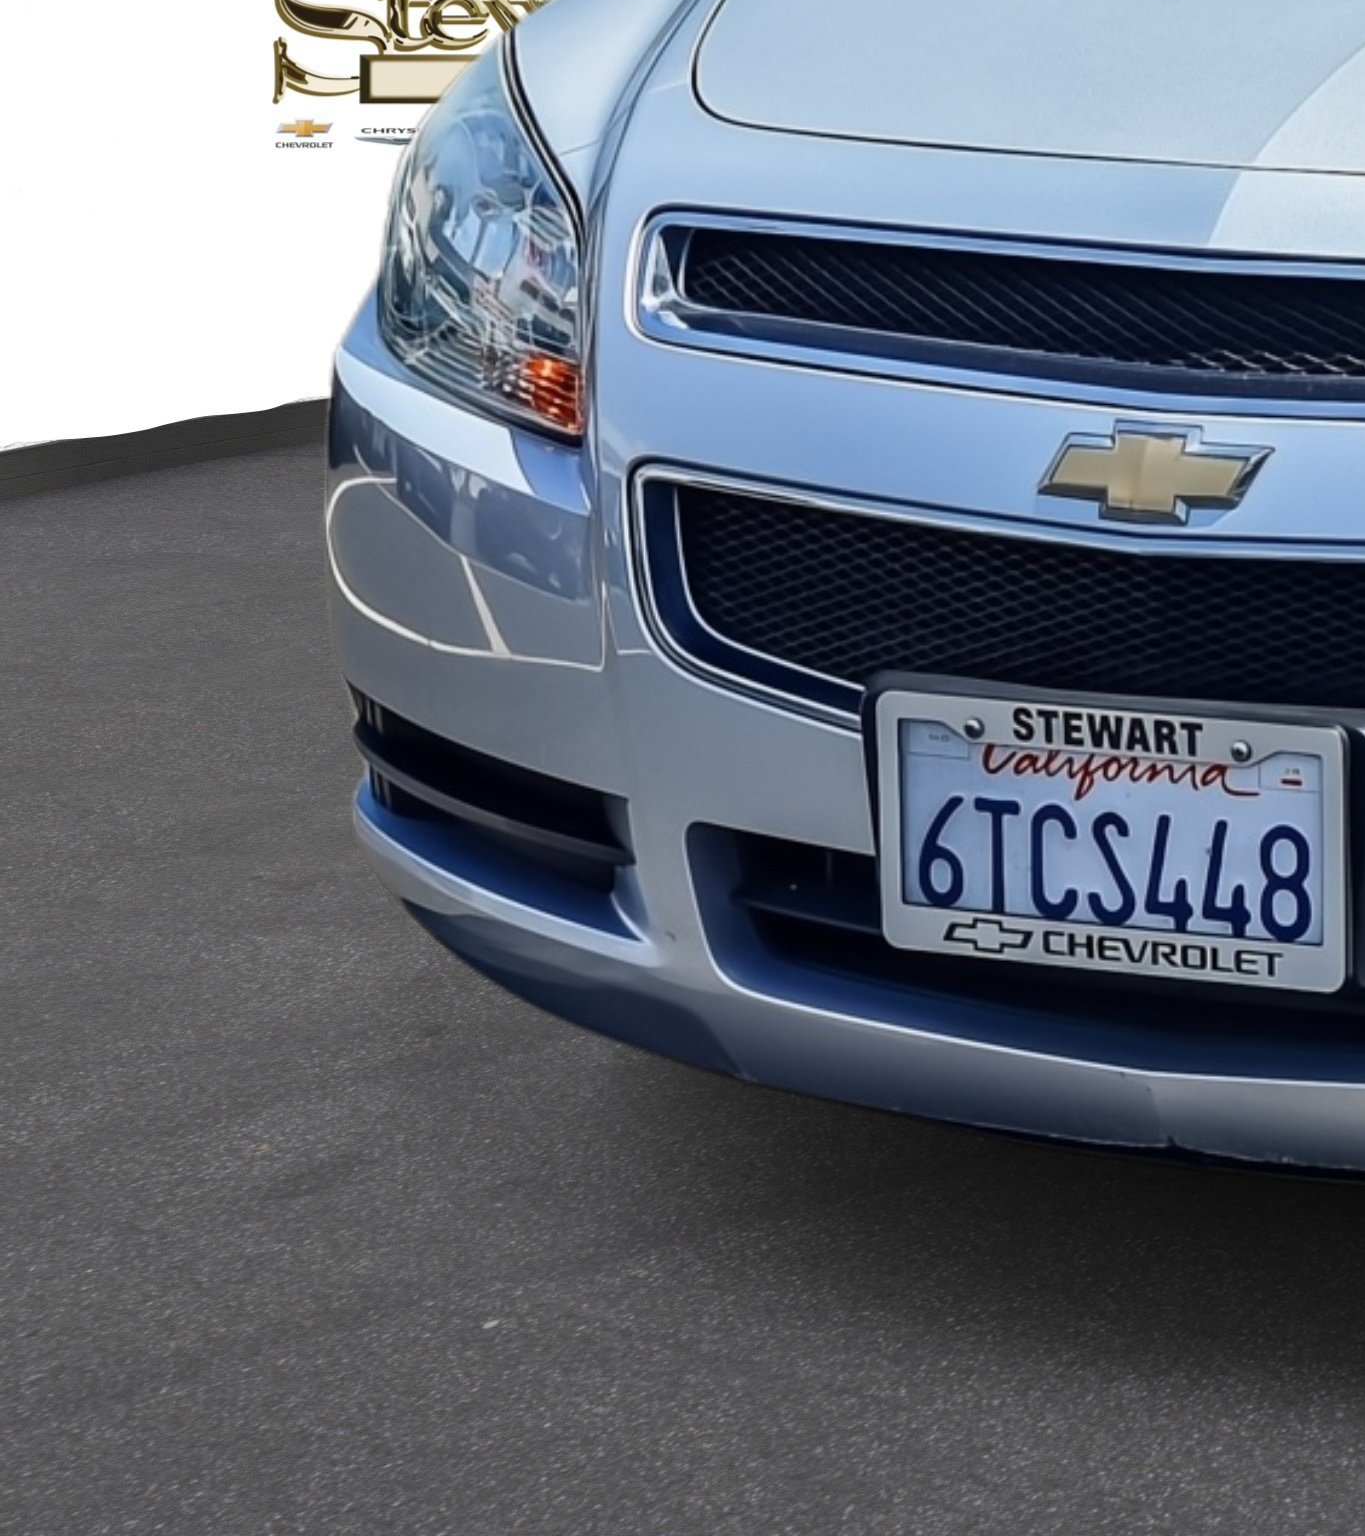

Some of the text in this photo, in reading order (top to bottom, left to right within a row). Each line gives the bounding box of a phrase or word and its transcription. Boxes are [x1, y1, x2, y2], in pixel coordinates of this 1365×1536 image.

[1012, 707, 1203, 756] STEWART
[981, 742, 1260, 799] California
[918, 795, 1312, 943] 6TCS448
[1041, 929, 1284, 978] CHEVROLET
